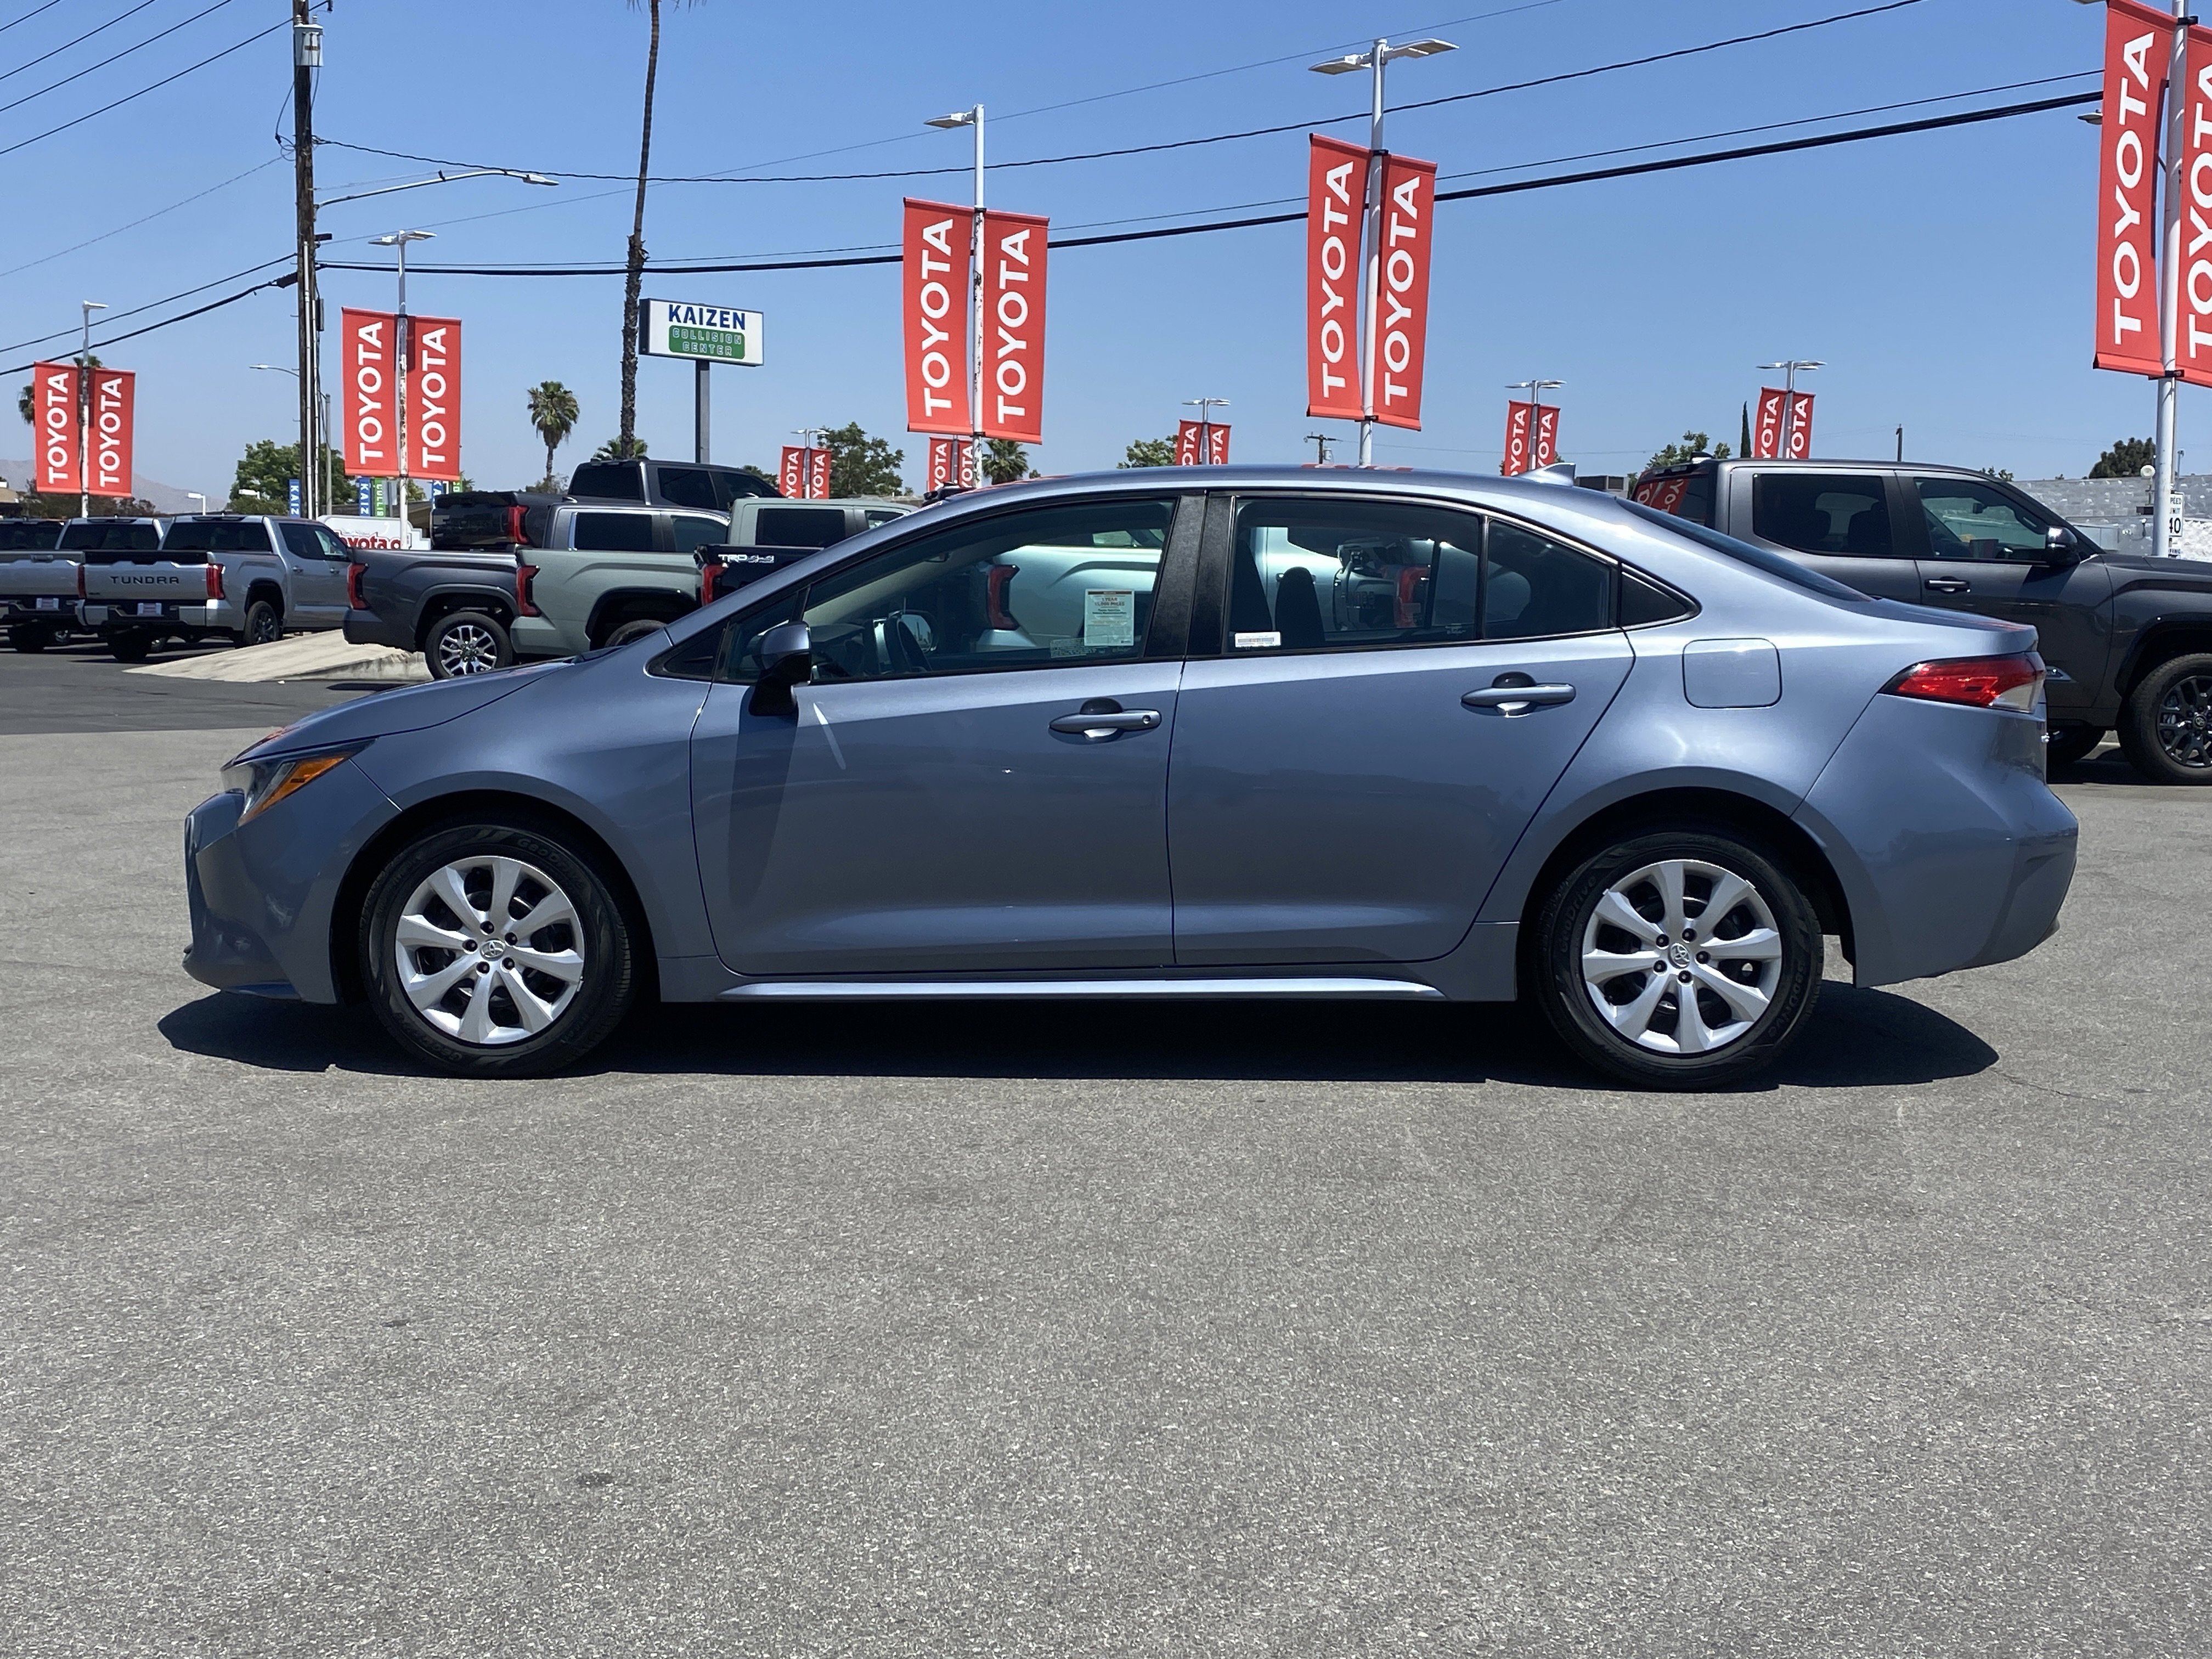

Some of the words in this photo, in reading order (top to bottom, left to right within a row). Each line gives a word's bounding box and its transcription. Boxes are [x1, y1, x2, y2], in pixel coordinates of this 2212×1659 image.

[2114, 31, 2155, 345] TOYOTA
[669, 304, 745, 330] KAIZEN
[673, 328, 742, 345] COLLISION
[682, 341, 732, 356] CENTER
[920, 218, 953, 417] TOYOTA
[996, 229, 1030, 424] TOYOTA
[1321, 161, 1353, 398] TOYOTA
[1384, 176, 1420, 406] TOYOTA
[47, 372, 69, 484] TOYOTA
[99, 377, 122, 487] TOYOTA
[357, 321, 383, 465] TOYOTA
[421, 327, 447, 468] TOYOTA
[718, 554, 747, 562] TRD
